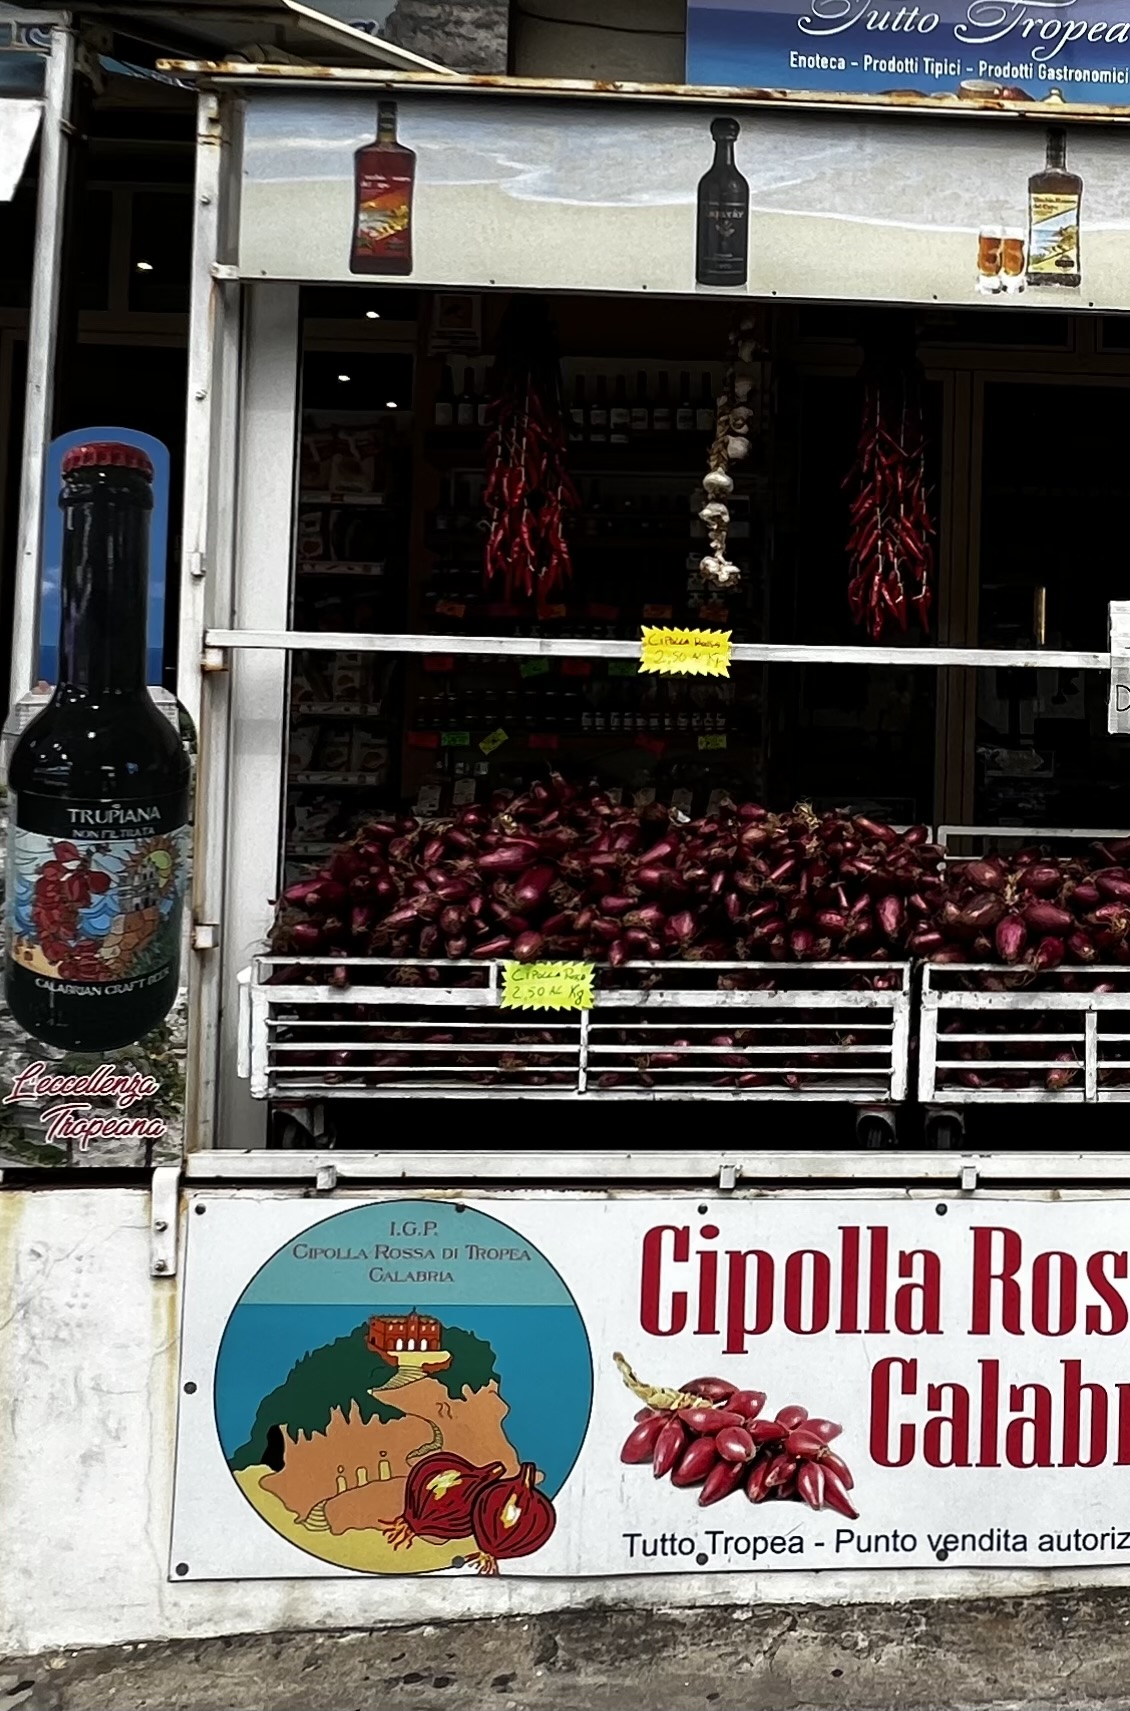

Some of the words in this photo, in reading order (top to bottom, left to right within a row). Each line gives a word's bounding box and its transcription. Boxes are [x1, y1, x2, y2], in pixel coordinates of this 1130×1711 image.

[797, 0, 939, 36] Tutto
[789, 51, 846, 71] Enoteca
[864, 56, 918, 75] Prodotti
[923, 58, 961, 79] Tipici
[979, 60, 1034, 78] Prodotti
[1038, 64, 1130, 84] Gastronomici
[66, 806, 161, 825] TRUPIANA
[72, 829, 99, 838] NON
[35, 977, 102, 997] CALABRIAN
[105, 979, 145, 996] CRAFT
[40, 1102, 168, 1151] Tropeana
[389, 1221, 438, 1237] I.G.P.
[640, 1224, 944, 1354] Cipolla
[623, 1532, 695, 1557] Tutto
[704, 1529, 804, 1560] Tropea
[835, 1529, 917, 1553] Punto
[930, 1527, 1028, 1553] vendita
